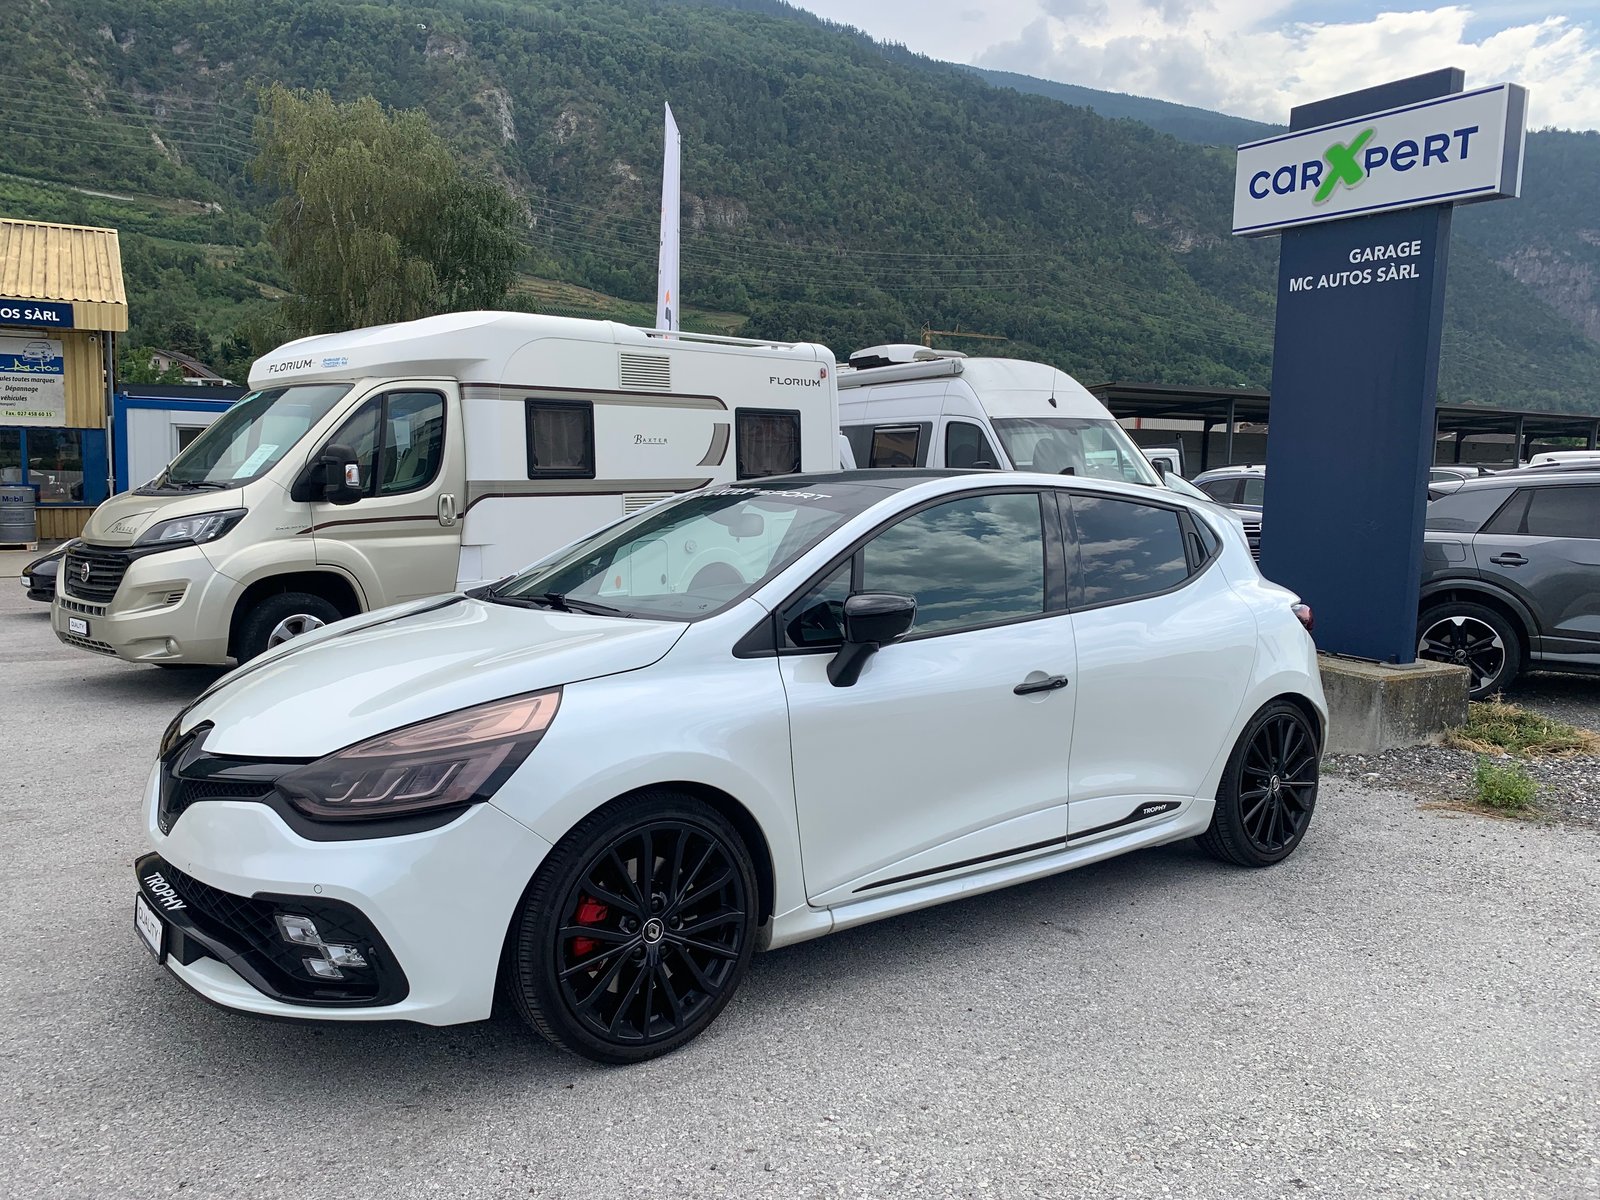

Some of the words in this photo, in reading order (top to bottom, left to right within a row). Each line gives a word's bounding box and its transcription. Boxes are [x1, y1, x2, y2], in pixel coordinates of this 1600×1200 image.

[1349, 240, 1421, 263] GARAGE
[1289, 276, 1313, 292] MC
[1317, 270, 1372, 289] AUTOS
[1376, 263, 1420, 282] SÀRL
[0, 308, 20, 319] OS
[24, 308, 60, 321] SÀRL
[269, 359, 312, 373] FLORIUM
[769, 377, 821, 387] FLORIUM
[5, 385, 38, 393] Dépannage
[1143, 804, 1167, 814] TROPHY
[144, 872, 187, 910] TROPHY
